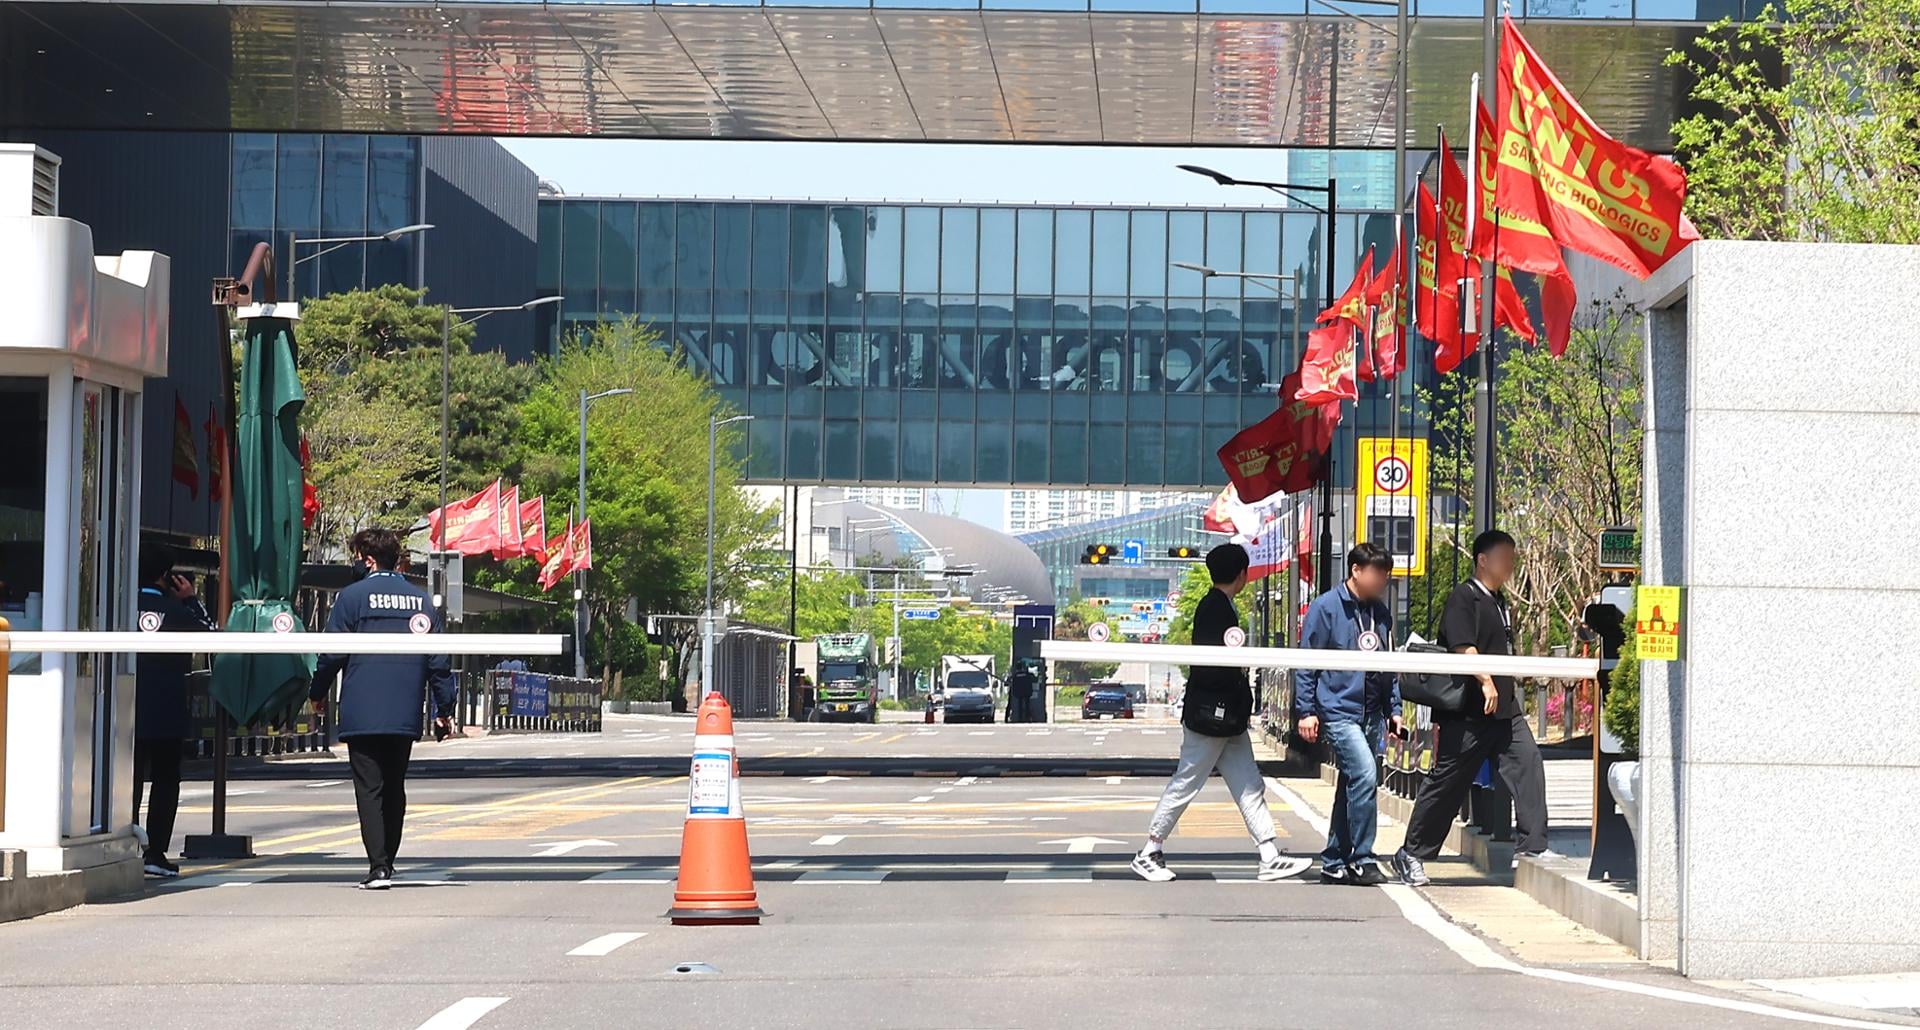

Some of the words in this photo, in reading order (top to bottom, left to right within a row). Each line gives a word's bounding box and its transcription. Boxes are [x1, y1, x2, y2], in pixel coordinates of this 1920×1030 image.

[1572, 186, 1661, 243] BIOLOGICS
[1380, 466, 1404, 483] 30
[369, 593, 423, 611] SECURITY
[1641, 636, 1674, 645] 교통사고
[1641, 645, 1673, 654] 위험지역
